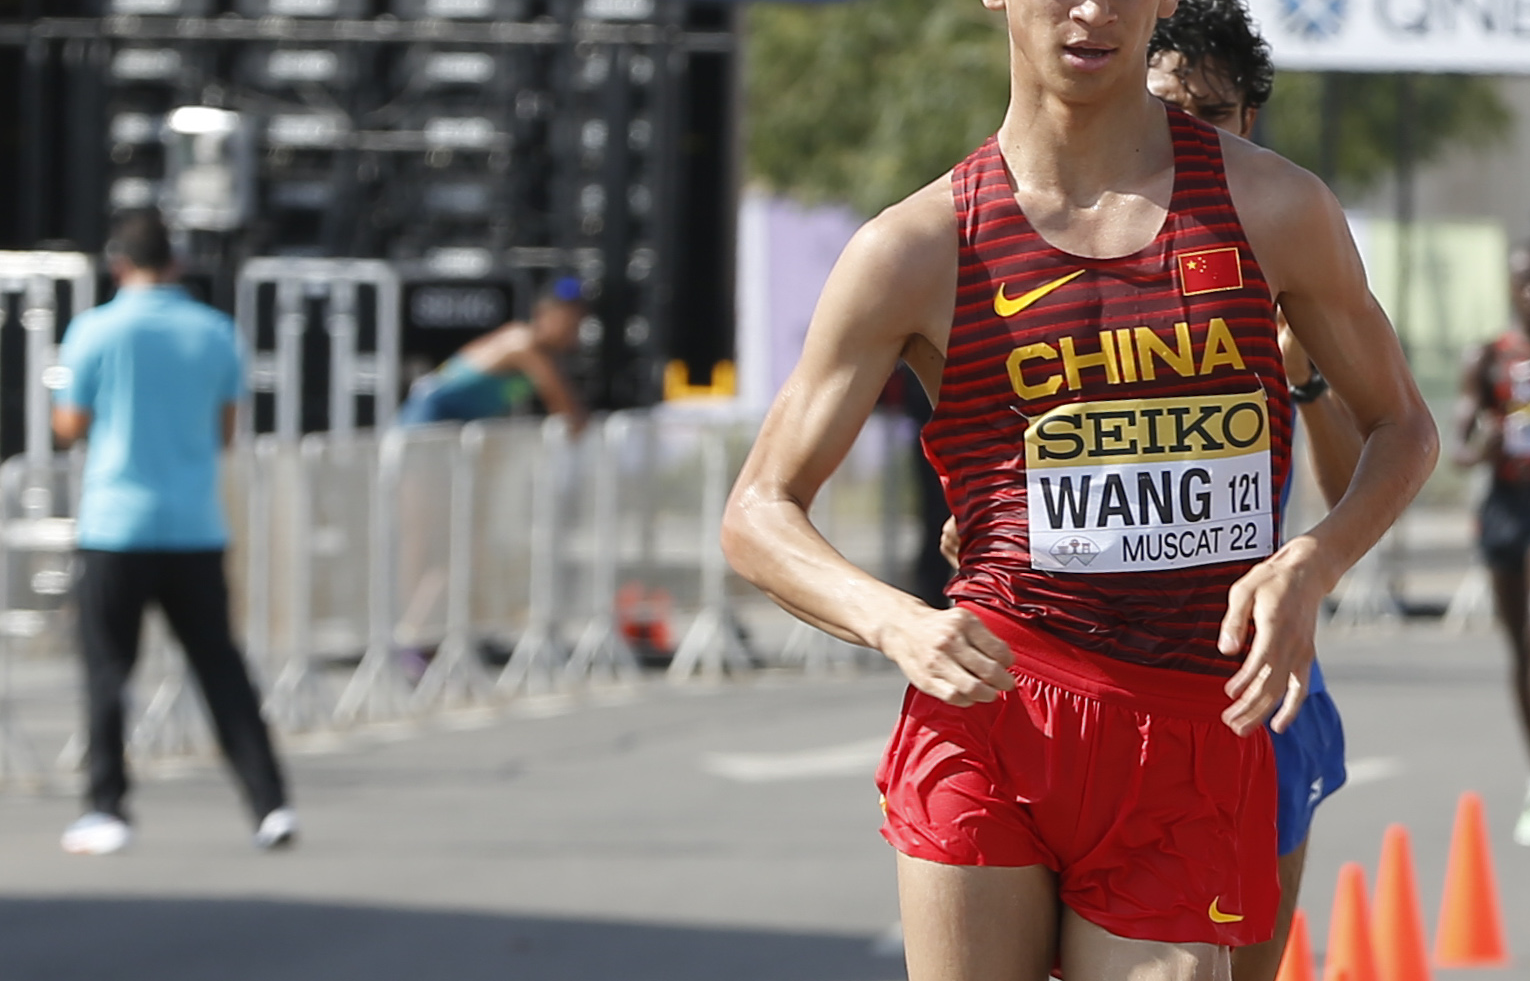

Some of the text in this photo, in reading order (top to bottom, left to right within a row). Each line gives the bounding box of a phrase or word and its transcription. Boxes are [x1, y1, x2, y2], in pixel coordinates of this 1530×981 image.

[1005, 317, 1247, 401] CHINA
[1036, 401, 1265, 461] SEIKO
[1039, 467, 1261, 531] WANG 121
[1121, 522, 1258, 562] MUSCAT 22
